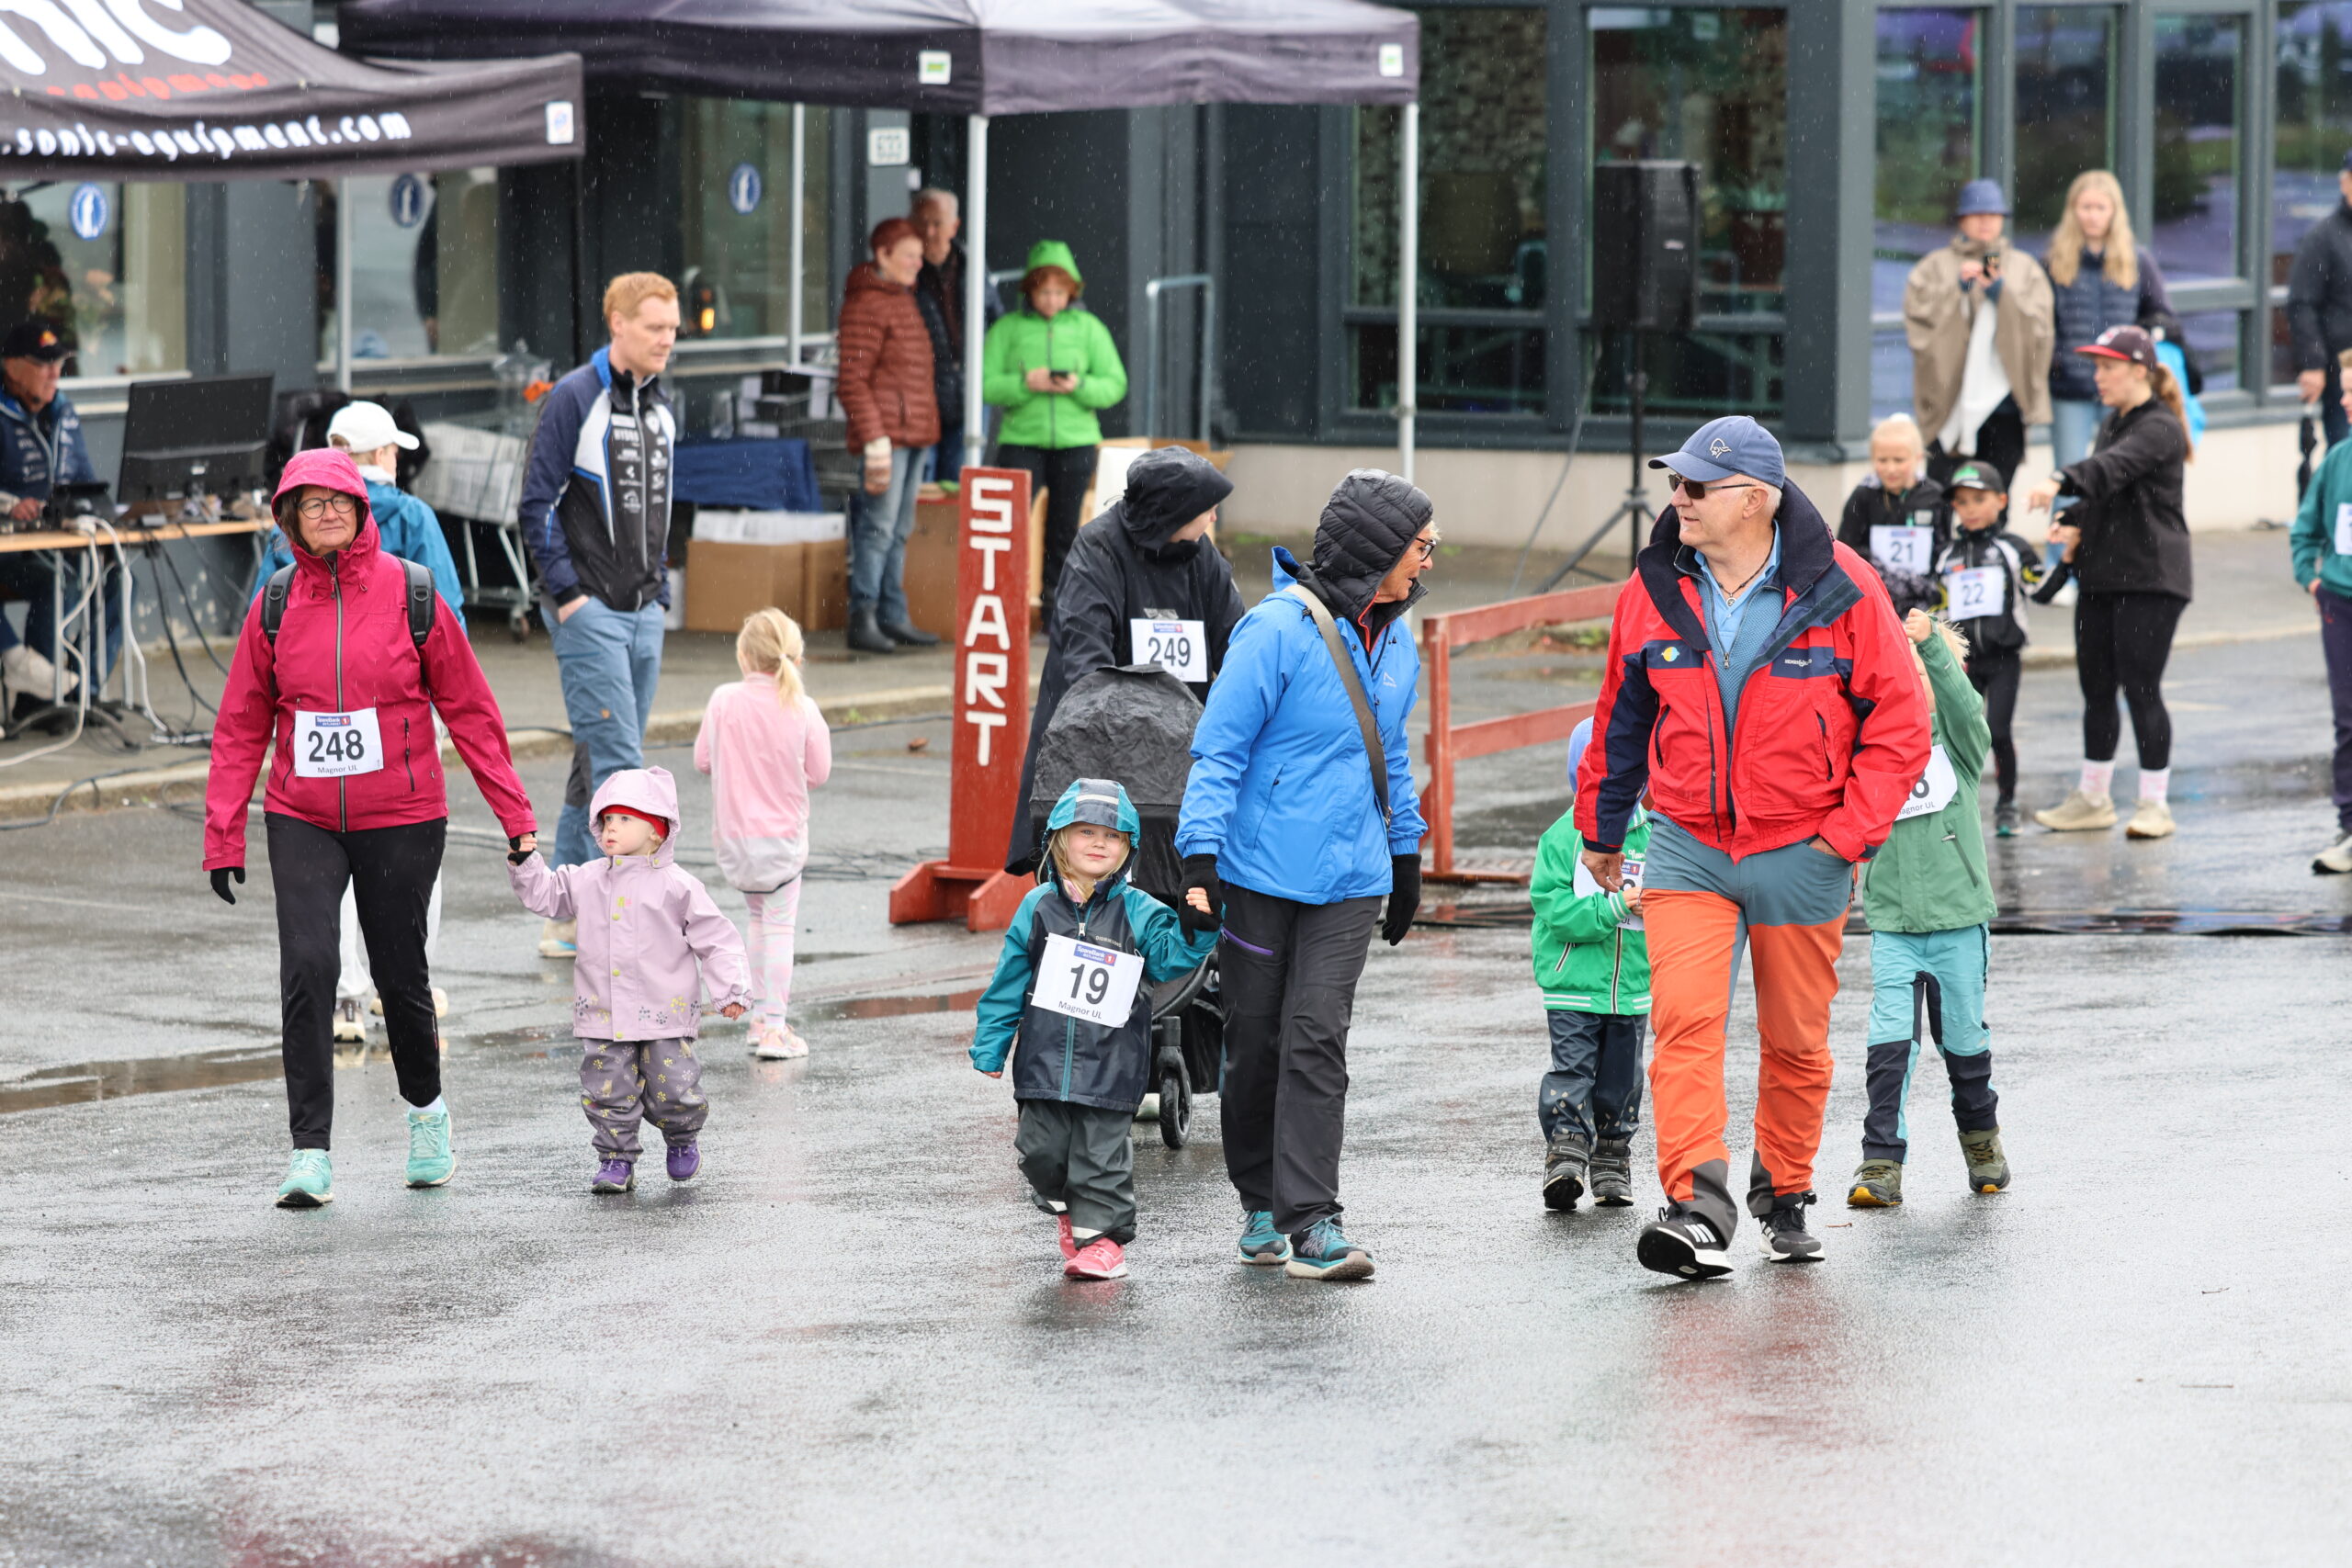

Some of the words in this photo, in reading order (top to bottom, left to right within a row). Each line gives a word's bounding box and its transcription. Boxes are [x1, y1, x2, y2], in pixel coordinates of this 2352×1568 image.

[1891, 541, 1914, 562] 21
[1962, 582, 1984, 605] 22
[965, 477, 1013, 766] START
[1148, 637, 1192, 668] 249
[308, 729, 365, 762] 248
[317, 766, 346, 775] Magnor
[1899, 804, 1924, 815] agnor
[1925, 801, 1936, 809] UL
[1070, 964, 1110, 1005] 19
[1058, 1000, 1091, 1016] Magnor
[1091, 1008, 1102, 1020] UL
